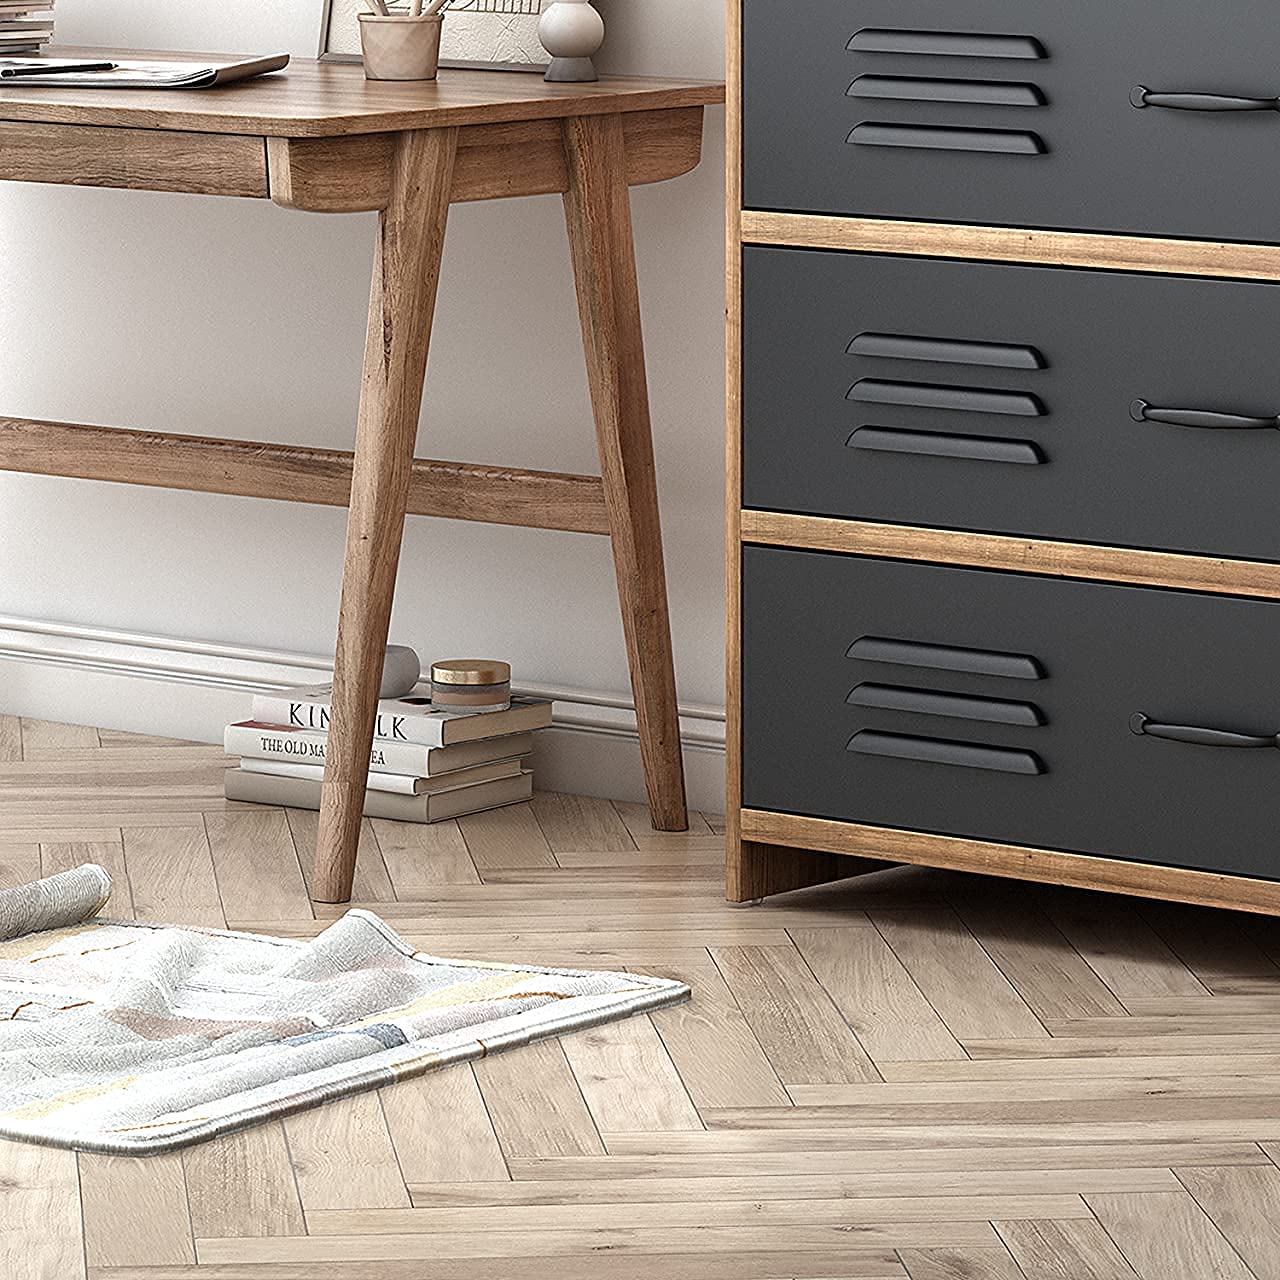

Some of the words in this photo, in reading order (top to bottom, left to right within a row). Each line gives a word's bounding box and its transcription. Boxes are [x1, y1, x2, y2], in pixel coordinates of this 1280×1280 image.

[290, 703, 408, 741] KINLK
[261, 737, 284, 753] THE
[284, 739, 308, 755] OLD
[309, 743, 328, 758] MA
[371, 750, 386, 765] EA
